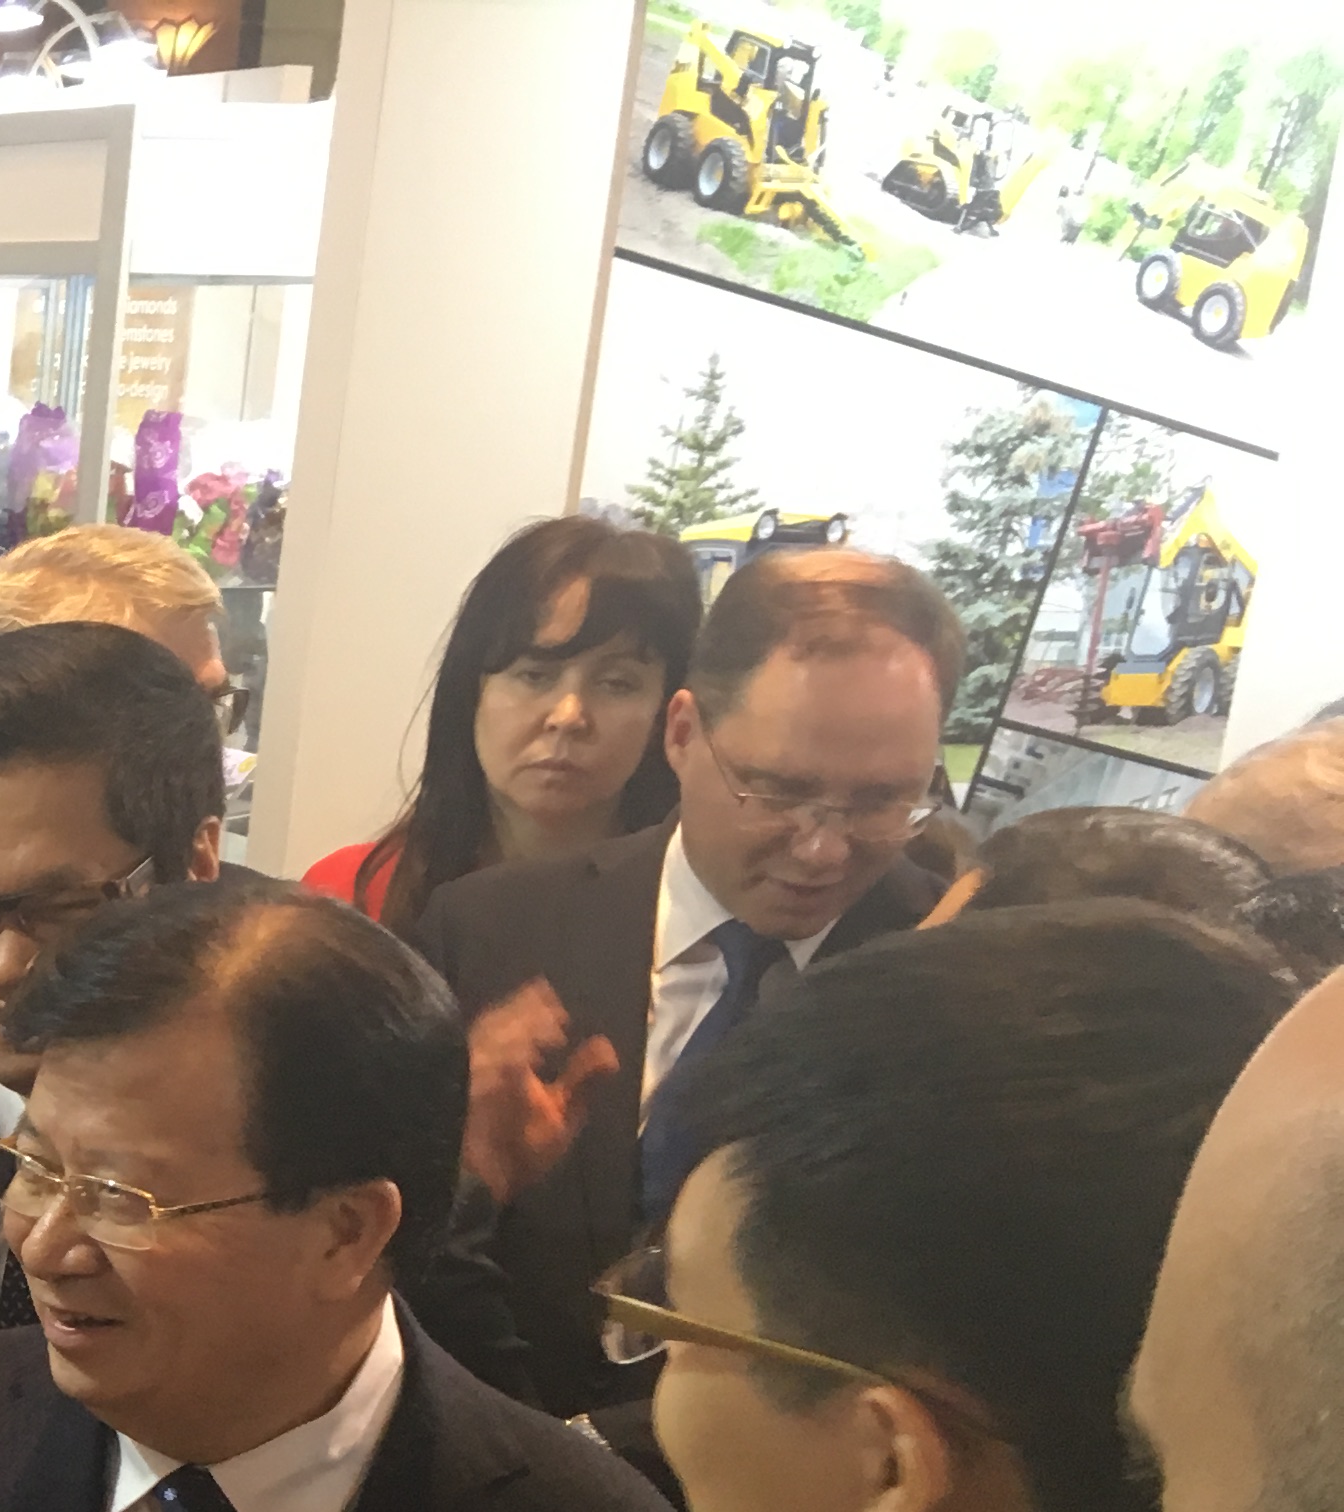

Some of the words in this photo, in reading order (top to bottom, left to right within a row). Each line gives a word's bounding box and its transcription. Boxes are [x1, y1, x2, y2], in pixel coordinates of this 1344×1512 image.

[125, 297, 177, 315] iamonds
[122, 325, 174, 343] emstones
[118, 380, 169, 403] o-design
